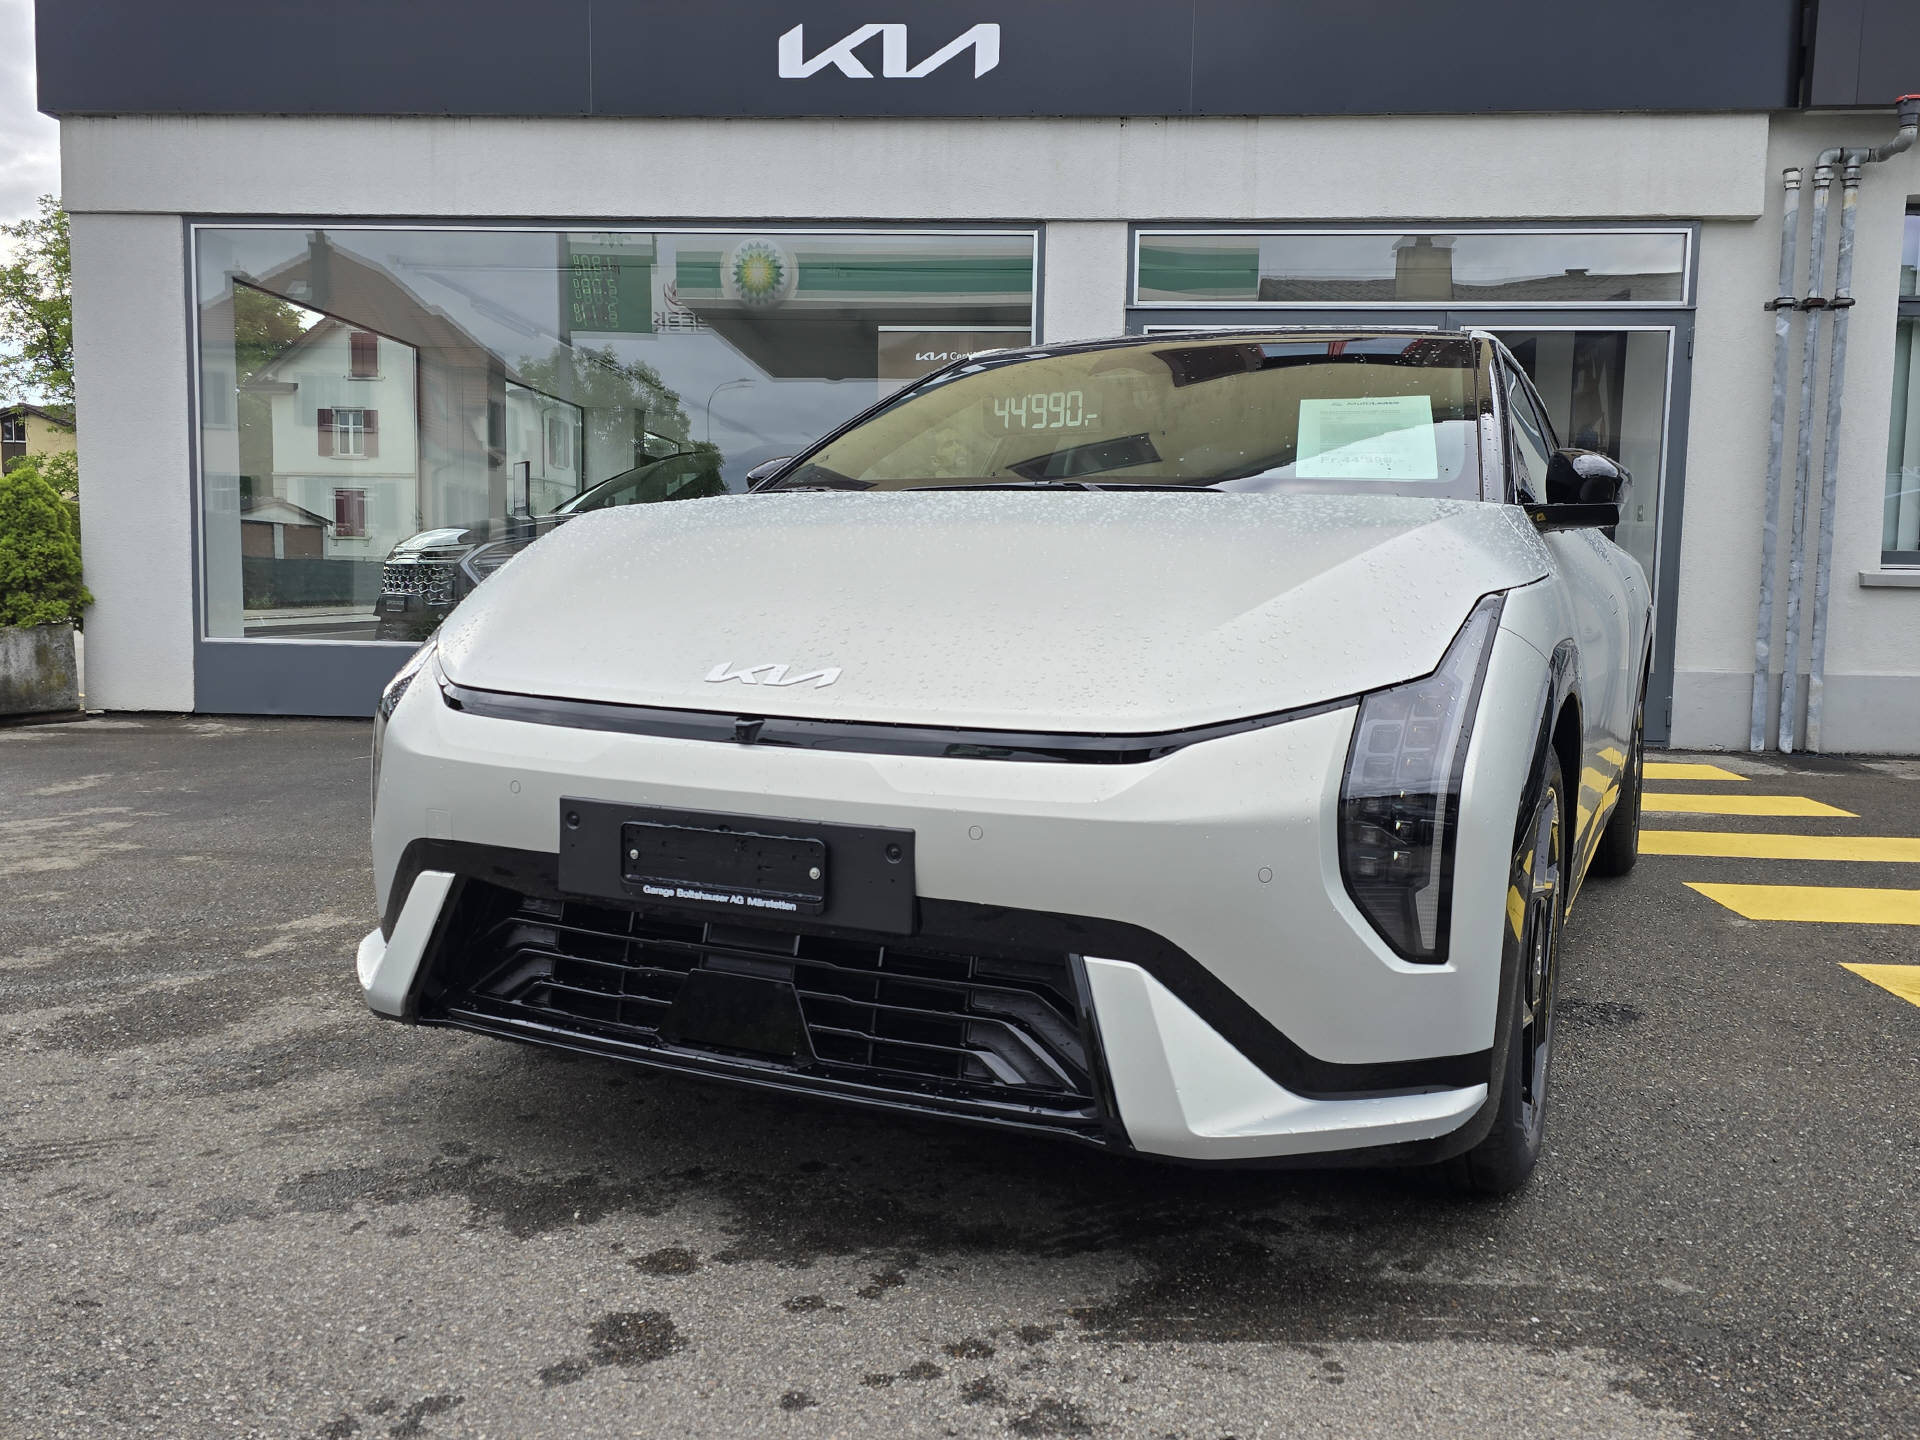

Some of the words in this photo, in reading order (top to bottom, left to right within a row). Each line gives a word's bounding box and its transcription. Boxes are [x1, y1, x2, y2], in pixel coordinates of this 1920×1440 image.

[778, 23, 1000, 79] KIA
[915, 352, 947, 360] KIA
[704, 661, 843, 690] KIA
[643, 885, 675, 898] Garage
[729, 895, 745, 905] AG
